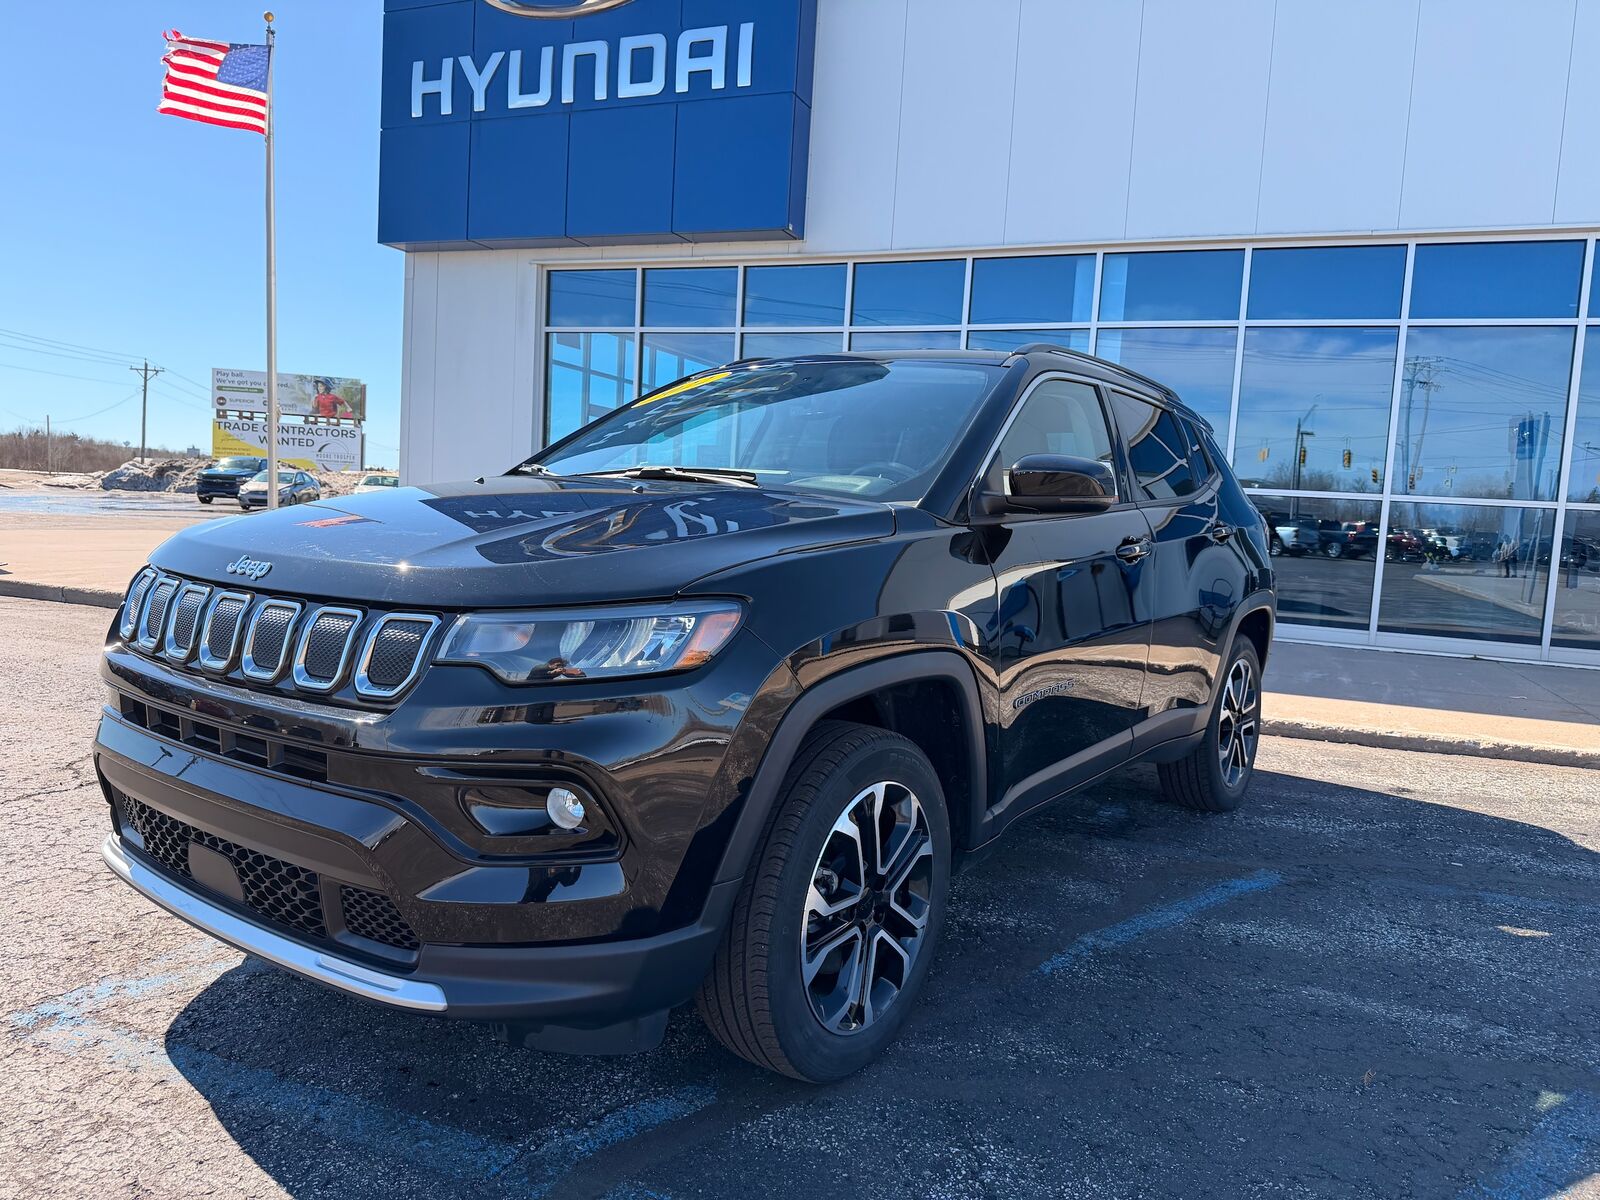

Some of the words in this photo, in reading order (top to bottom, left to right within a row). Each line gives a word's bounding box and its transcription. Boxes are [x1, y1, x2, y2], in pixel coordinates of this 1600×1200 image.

[411, 22, 754, 118] HYUNDAI
[216, 370, 230, 378] Play
[236, 379, 248, 387] got
[216, 421, 259, 433] TRADE
[262, 424, 357, 439] CNTRACTORS
[226, 554, 273, 581] Jeep
[1013, 678, 1076, 710] COMPASS
